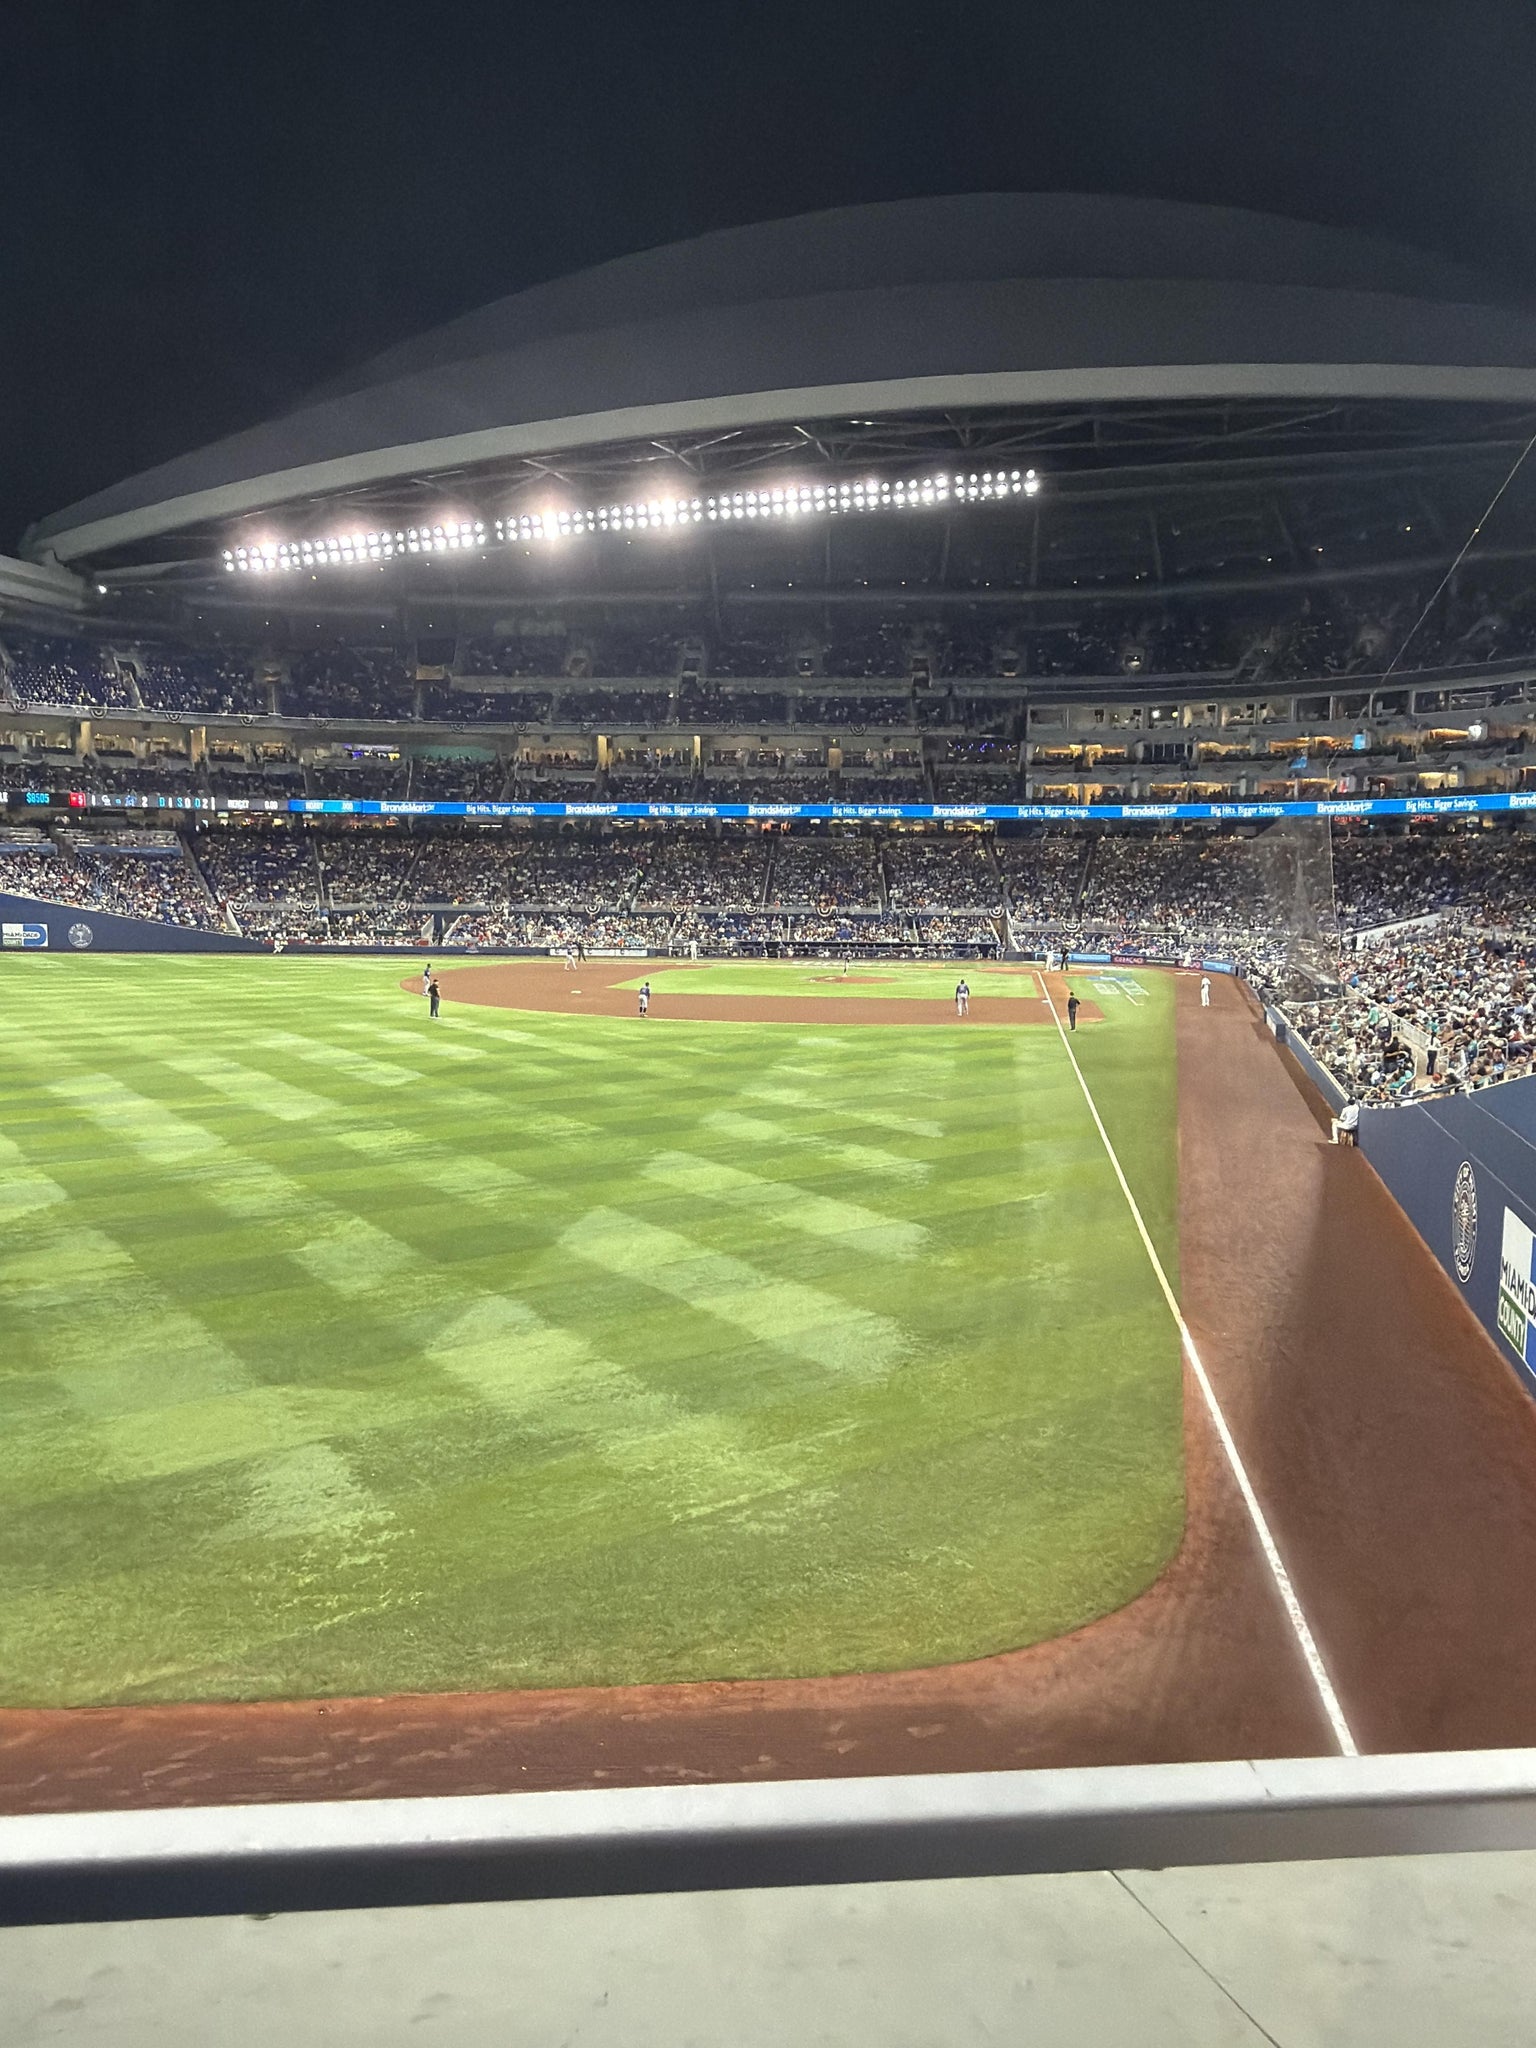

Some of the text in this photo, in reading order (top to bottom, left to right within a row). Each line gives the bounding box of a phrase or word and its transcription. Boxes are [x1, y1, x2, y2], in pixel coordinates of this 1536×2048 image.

[380, 802, 428, 813] BrandsMart
[466, 805, 476, 815] Big
[492, 805, 511, 815] Bigger
[566, 804, 611, 815] BrandsMart
[649, 806, 658, 815] Big
[674, 806, 693, 816] Bigger
[749, 805, 794, 816] BrandsMart
[832, 806, 842, 816] Big
[858, 806, 877, 817] Bigger
[933, 806, 980, 816] BrandsMart
[1122, 806, 1170, 817] BrandsMart
[1210, 806, 1221, 817] Big
[1238, 806, 1257, 817] Bigger
[1317, 802, 1365, 814] BrandsMart
[1406, 801, 1416, 812] Big
[1434, 800, 1452, 812] Bigger
[1018, 807, 1028, 817] Big
[1044, 807, 1064, 817] Bigger
[1500, 1295, 1525, 1348] COUNTY
